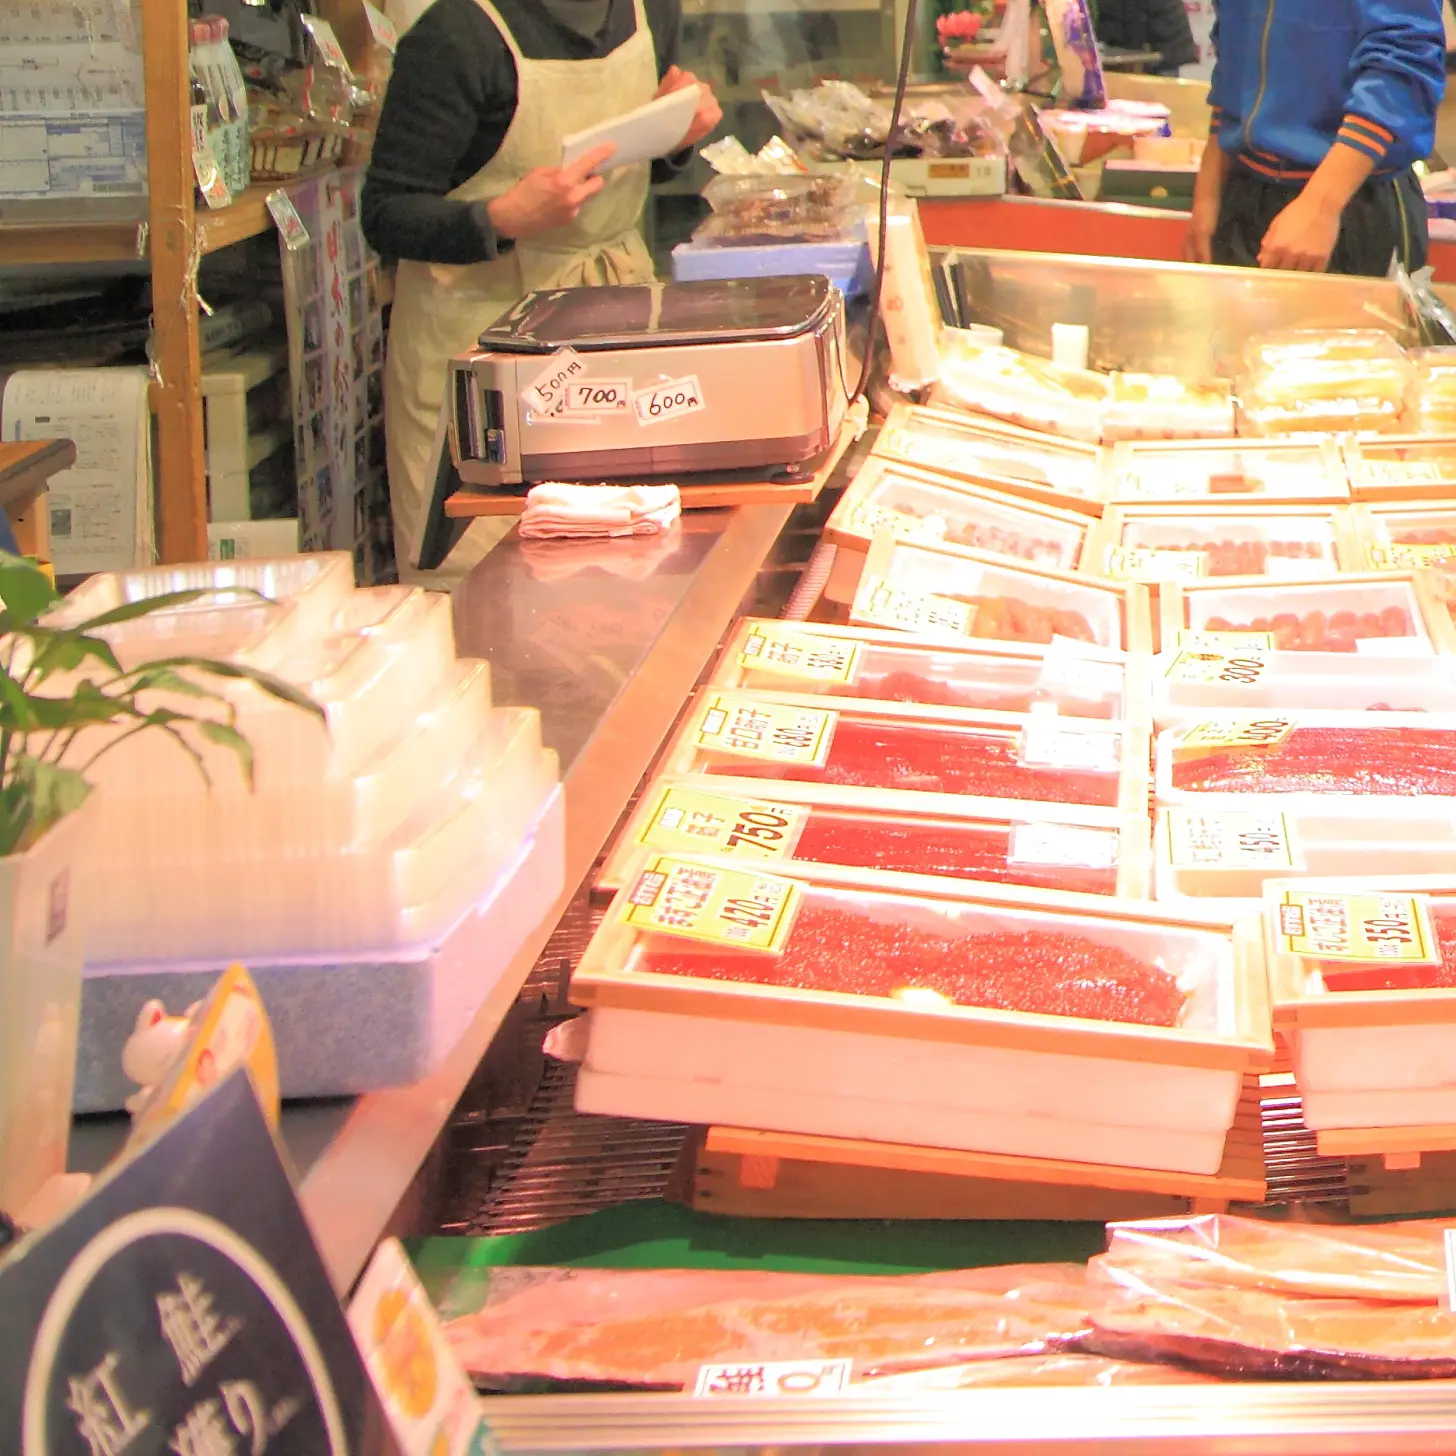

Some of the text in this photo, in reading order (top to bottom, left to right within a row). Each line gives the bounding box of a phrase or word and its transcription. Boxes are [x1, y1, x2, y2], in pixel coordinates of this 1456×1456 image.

[534, 361, 582, 403] 500円
[578, 386, 627, 408] 700円
[649, 392, 699, 416] 600円
